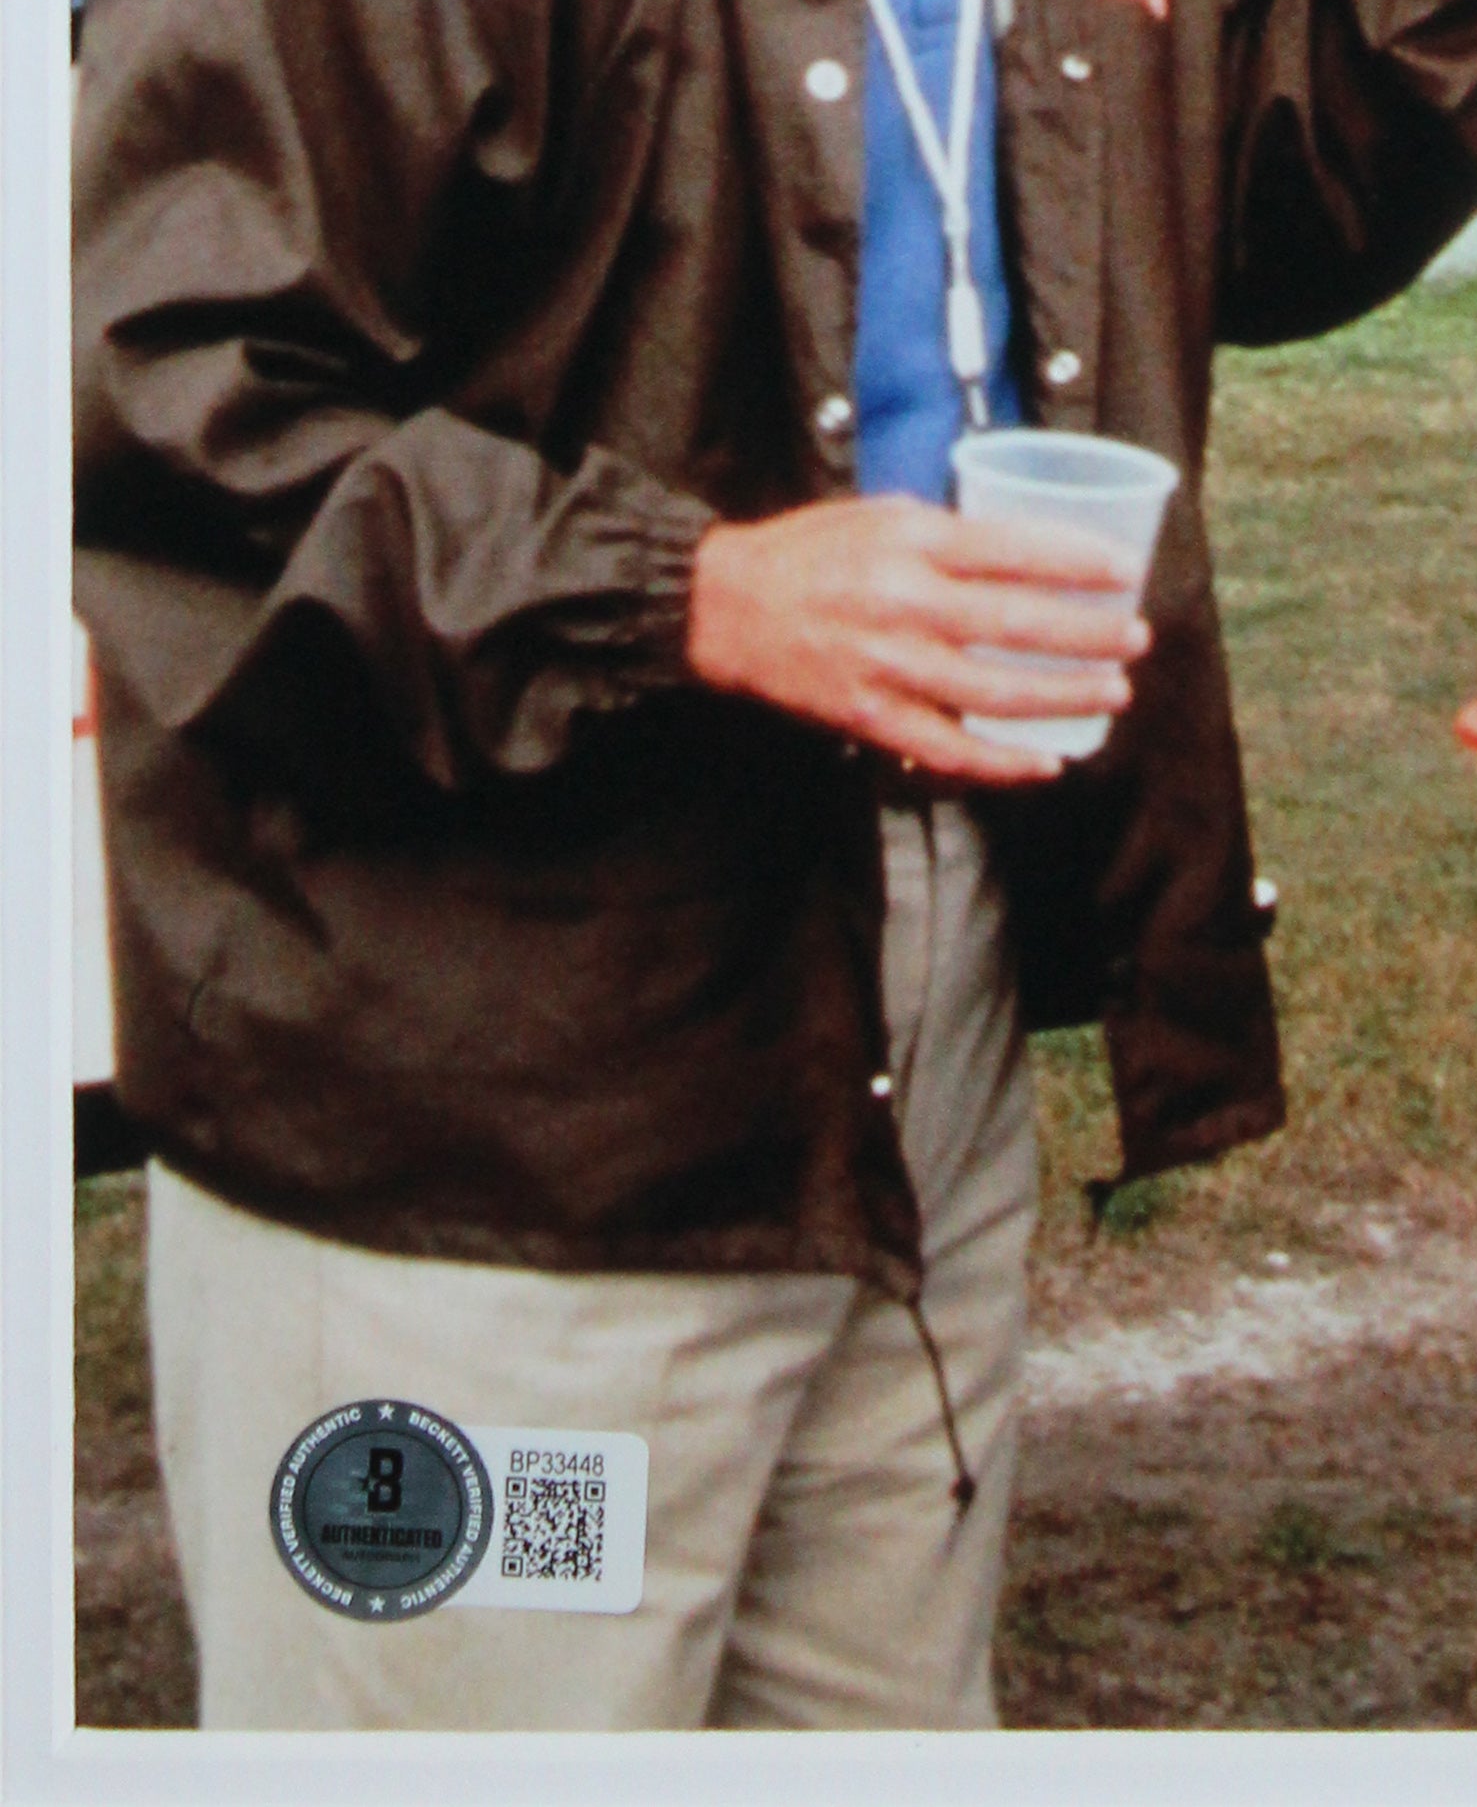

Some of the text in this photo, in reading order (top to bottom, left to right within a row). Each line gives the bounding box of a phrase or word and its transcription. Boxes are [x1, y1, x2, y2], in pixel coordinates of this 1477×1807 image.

[366, 1447, 404, 1513] B
[510, 1449, 604, 1477] BP33448
[278, 1407, 362, 1607] BECKETT VERIFIED AUTHENTIC
[320, 1523, 443, 1549] AUTHENTICATED
[400, 1410, 484, 1610] BECKETT VERIFIED AUTHENTIC
